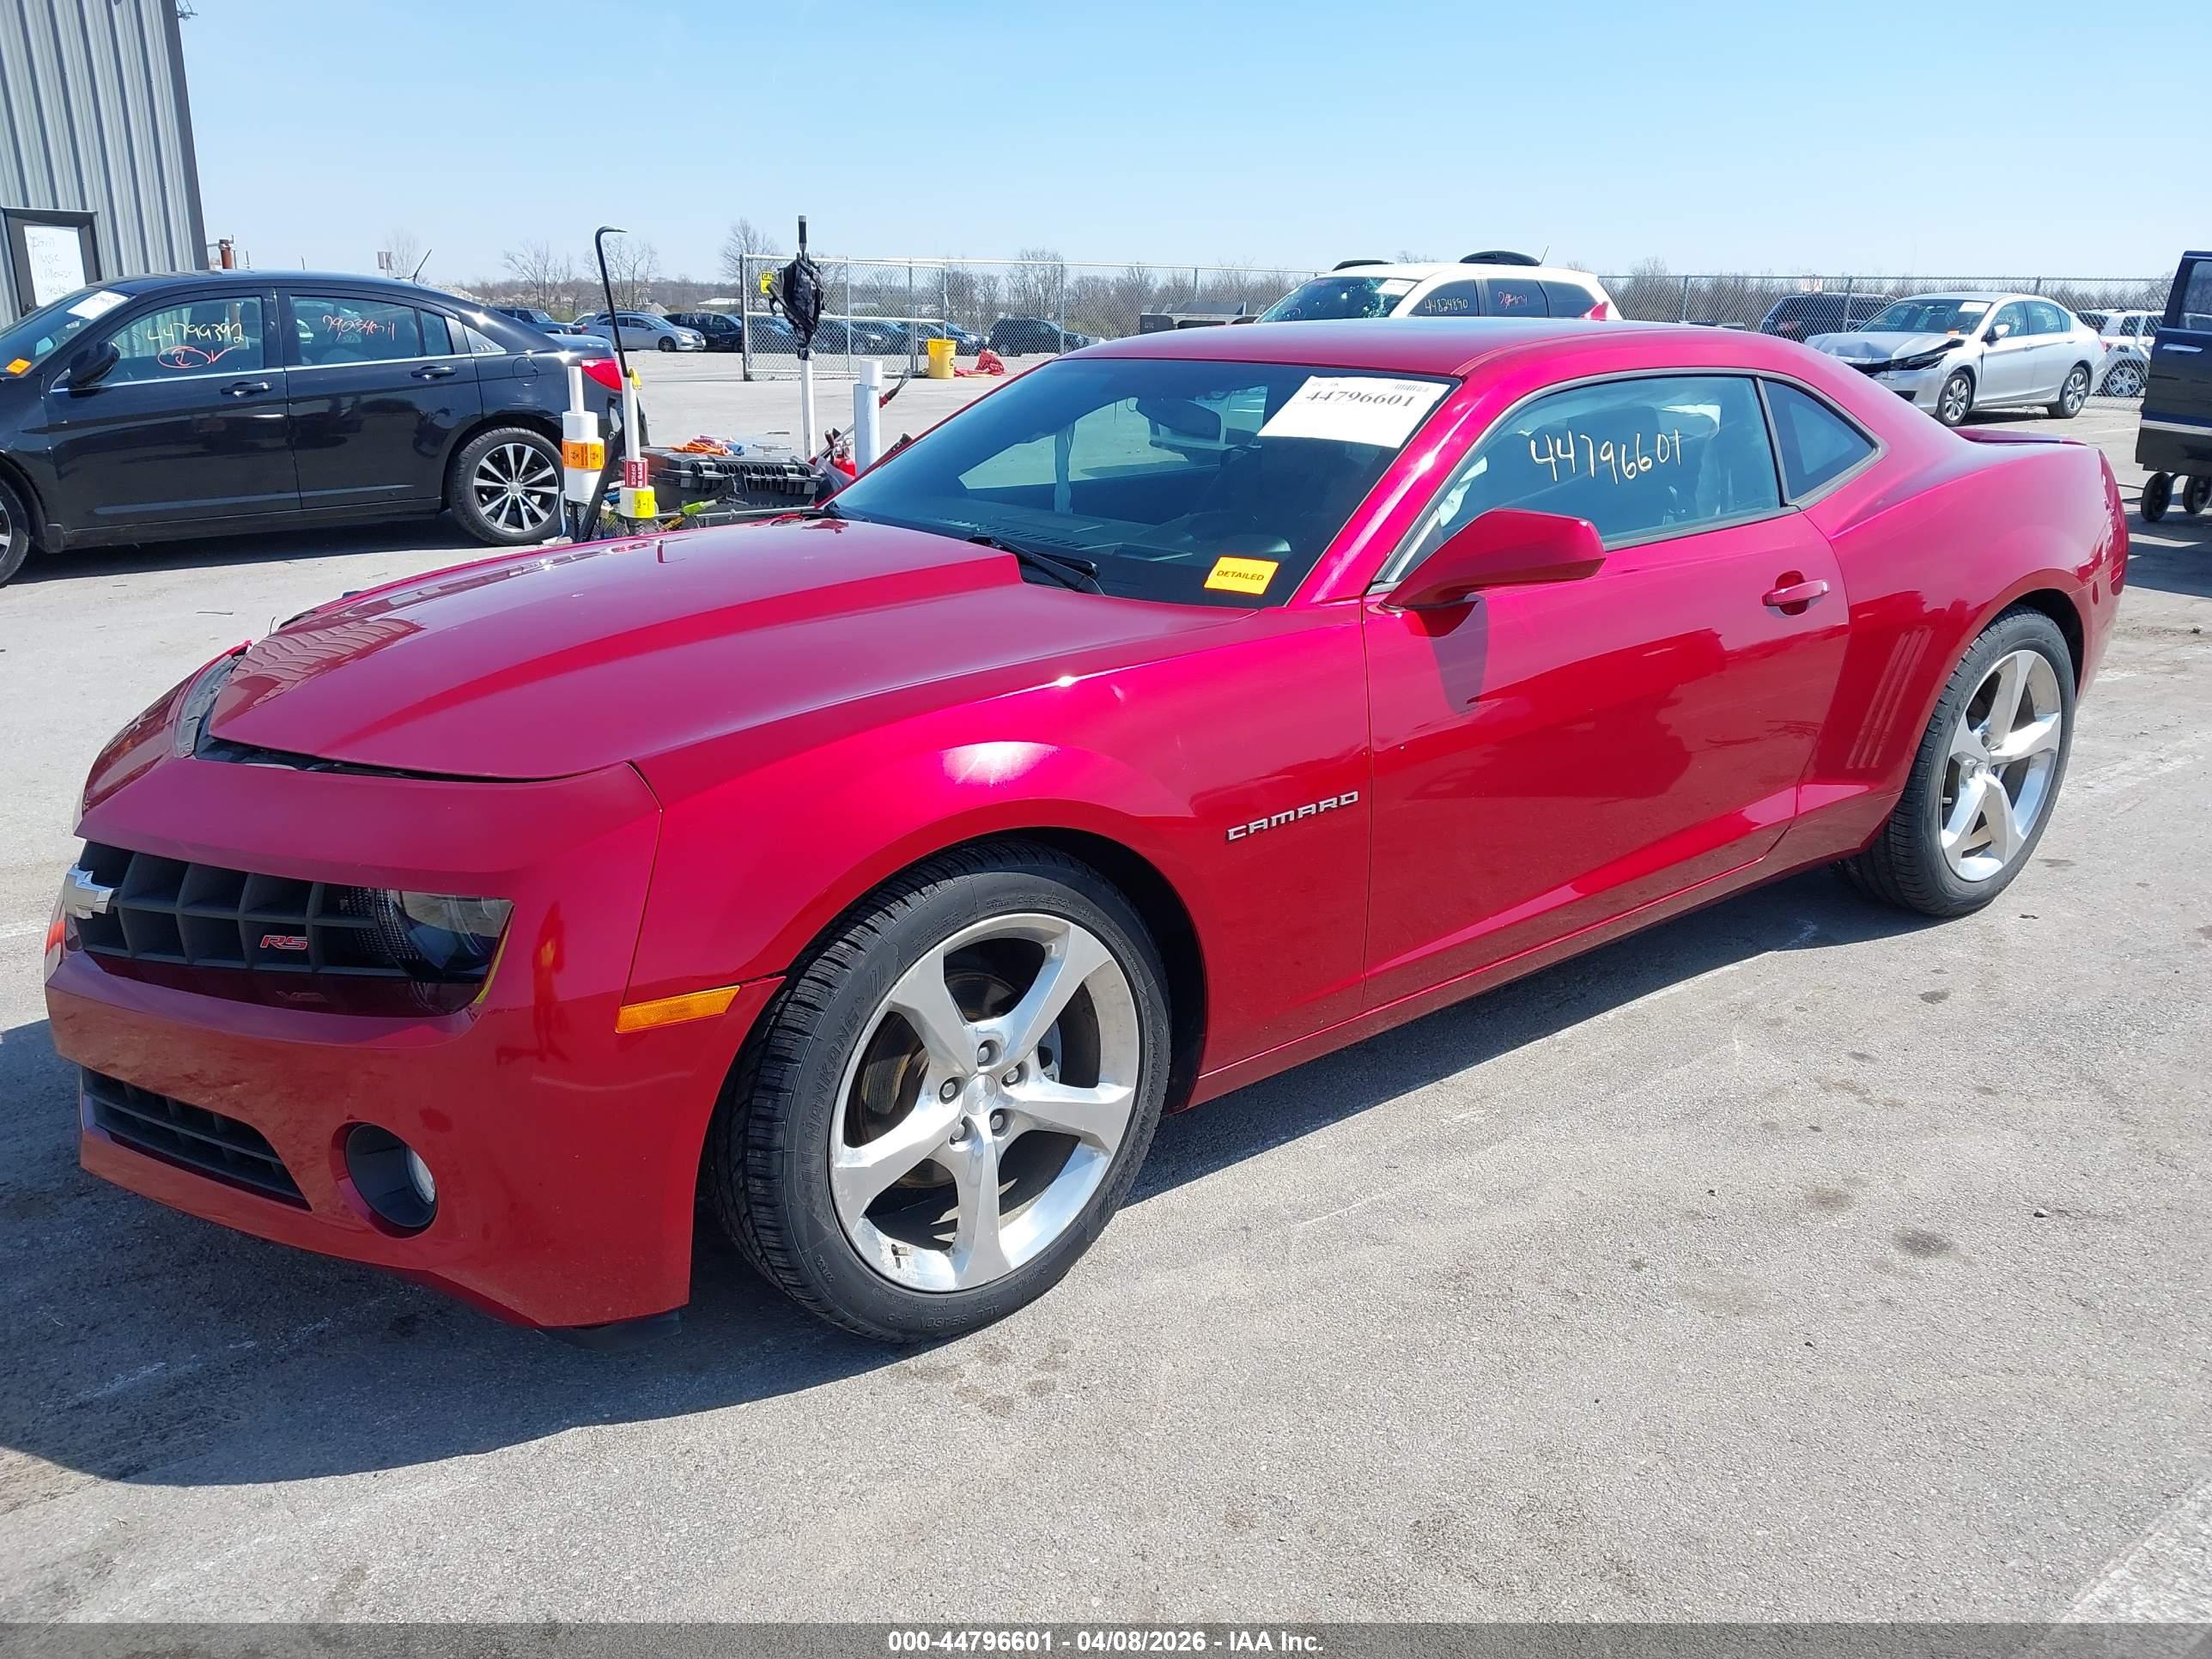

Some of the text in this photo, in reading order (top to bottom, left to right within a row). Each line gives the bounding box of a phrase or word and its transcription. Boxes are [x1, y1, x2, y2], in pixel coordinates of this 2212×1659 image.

[147, 322, 245, 349] 44799392
[1306, 391, 1416, 407] 44796601
[1530, 428, 1682, 485] 44796601
[1216, 569, 1265, 581] DETAILED
[1226, 790, 1359, 842] CAMARO
[259, 934, 308, 951] RS
